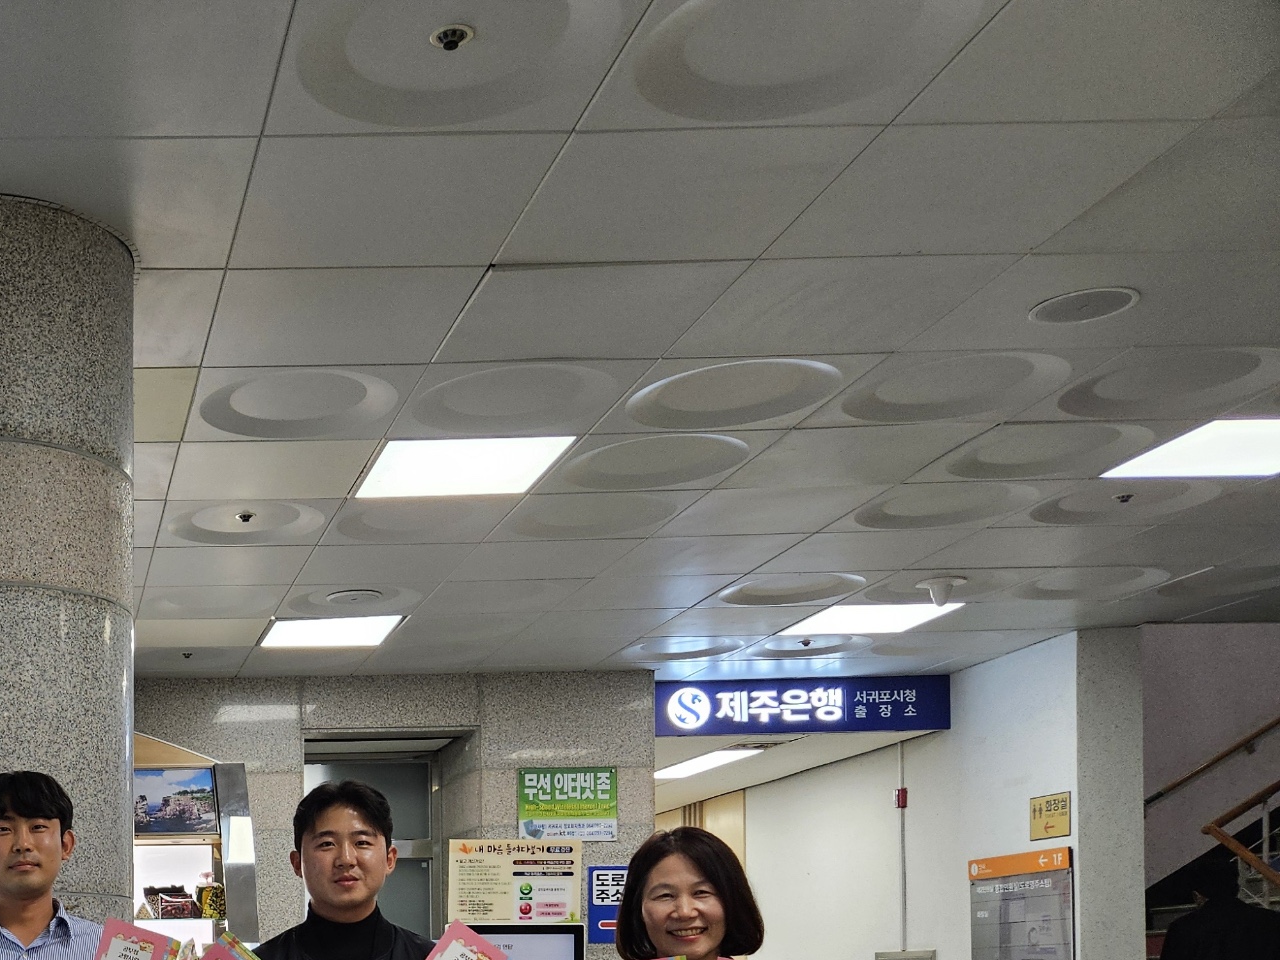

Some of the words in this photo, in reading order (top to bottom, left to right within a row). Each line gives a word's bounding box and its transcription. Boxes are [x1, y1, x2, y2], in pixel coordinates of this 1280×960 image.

[854, 689, 917, 703] 서귀포시청
[715, 687, 843, 722] 제주은행
[524, 773, 551, 800] 무선
[554, 773, 595, 800] 인터넷
[597, 772, 611, 799] 존
[1045, 798, 1068, 812] 화장실
[474, 845, 484, 854] 내
[487, 845, 503, 855] 마음
[506, 844, 545, 856] 들여다보기
[1053, 853, 1063, 866] 1F
